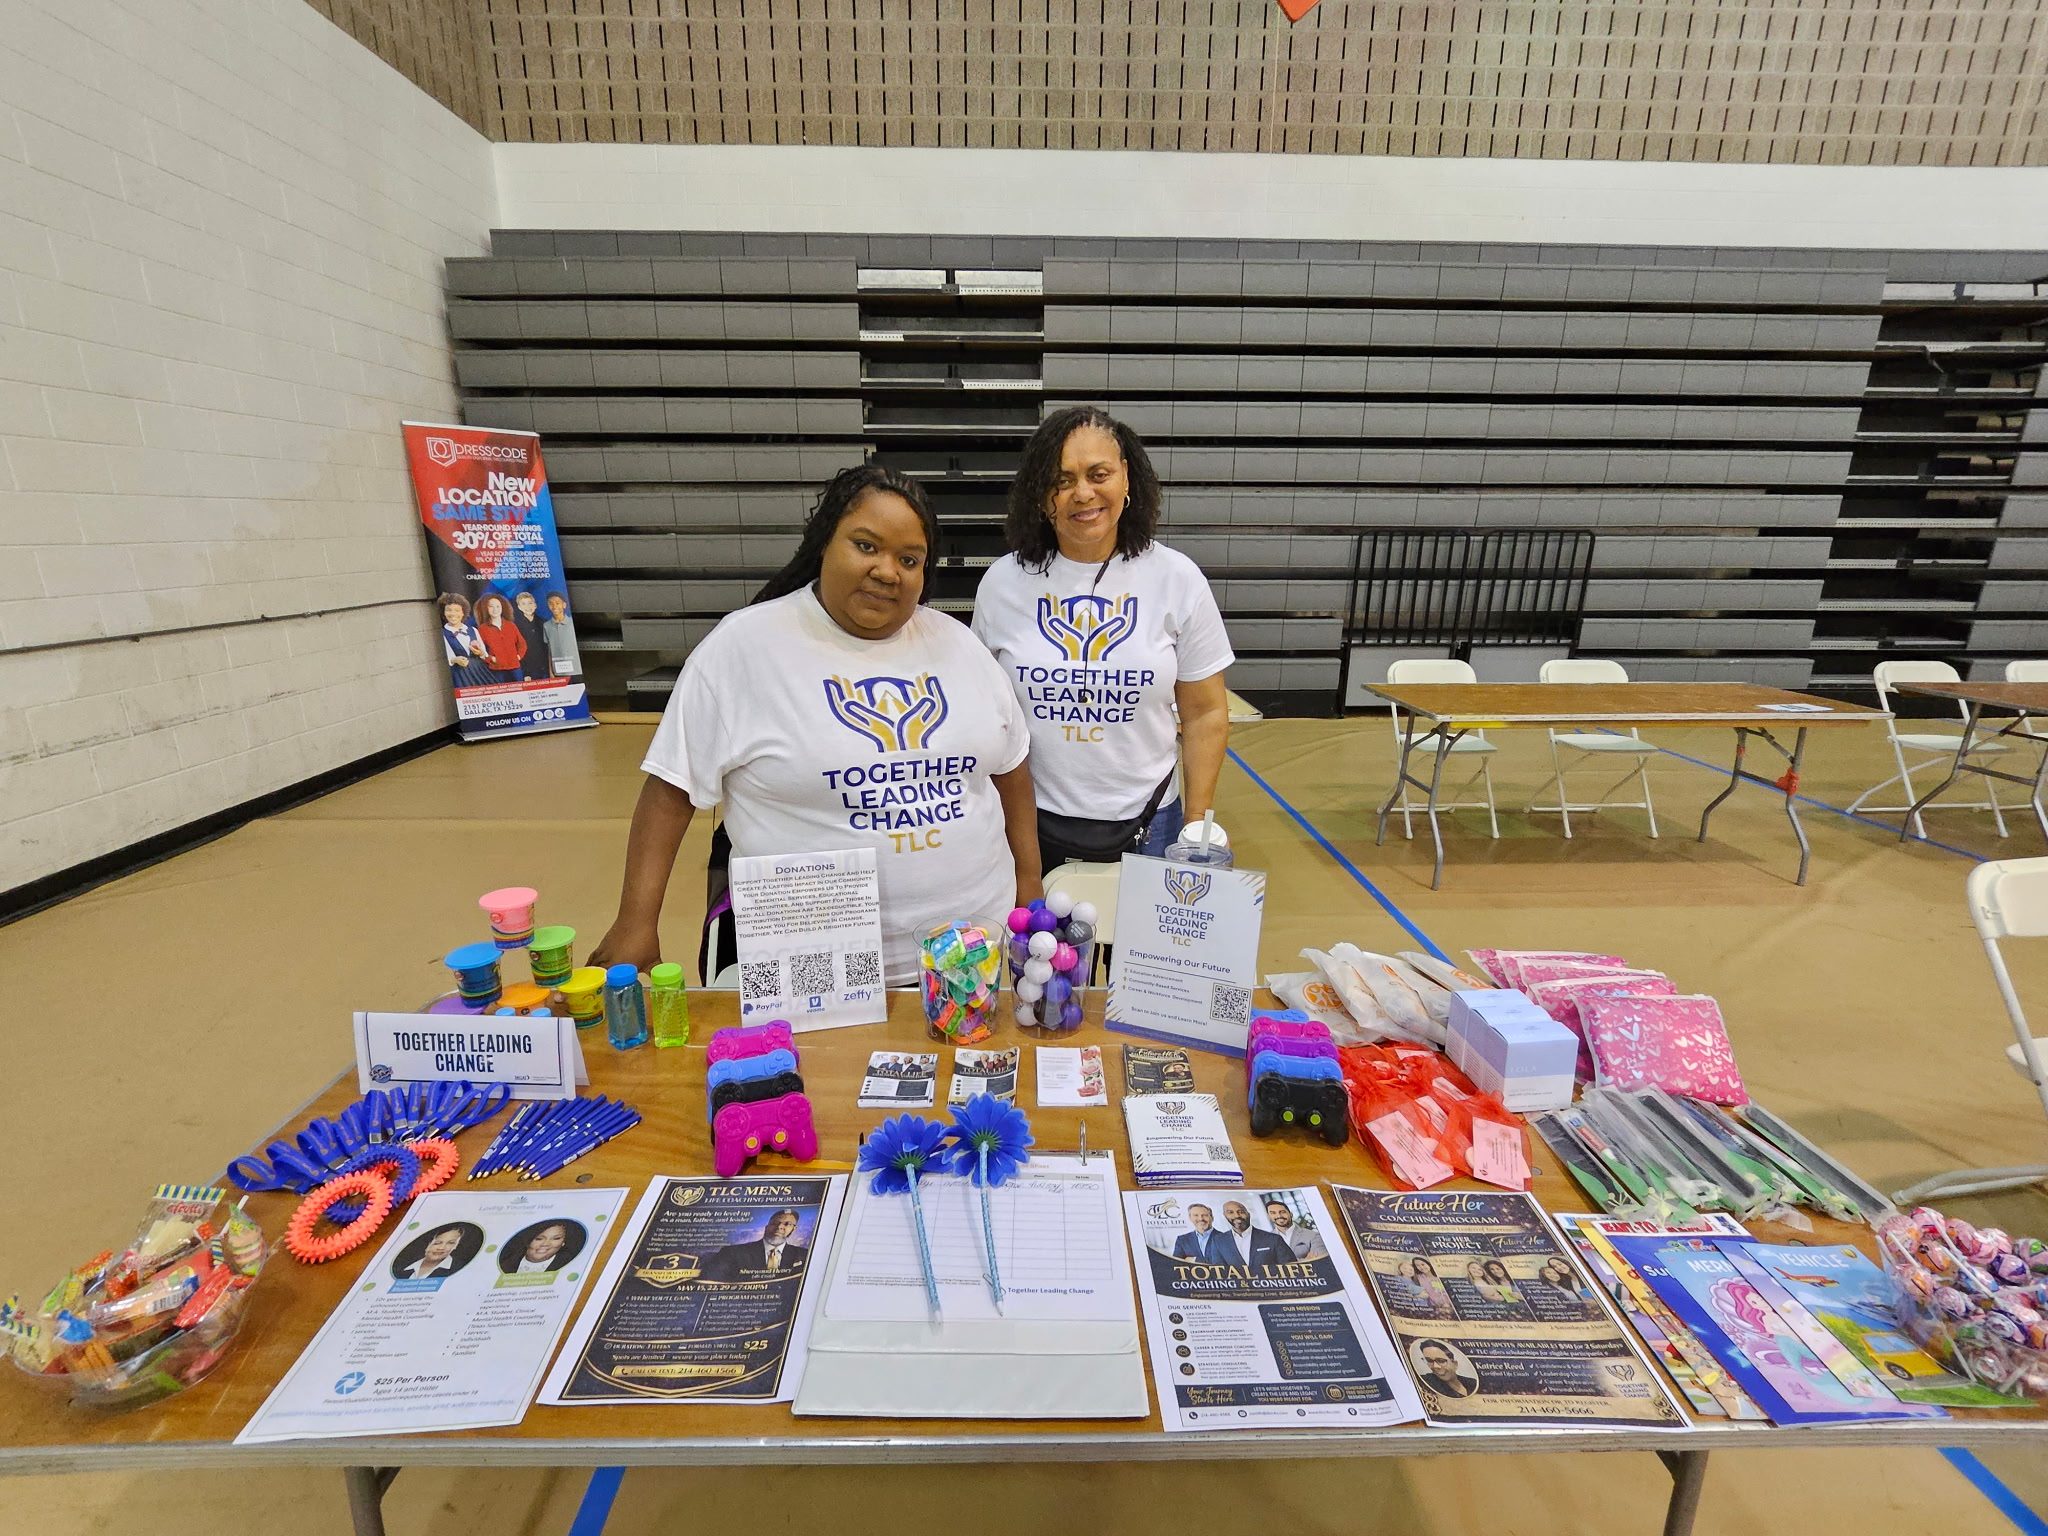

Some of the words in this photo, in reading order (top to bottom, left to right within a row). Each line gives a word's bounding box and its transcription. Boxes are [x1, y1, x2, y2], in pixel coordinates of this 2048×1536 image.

[455, 444, 527, 460] DRESSCODE
[488, 472, 536, 491] New
[438, 487, 538, 507] LOCATION
[431, 504, 486, 521] SAME
[511, 524, 542, 532] SAVINGS
[452, 531, 496, 549] 30%
[492, 531, 512, 540] OFF
[514, 532, 544, 541] TOTAL
[1016, 666, 1155, 687] TOGETHER
[1028, 686, 1141, 705] LEADING
[503, 703, 523, 711] 75229
[1033, 705, 1136, 723] CHANGE
[485, 719, 511, 727] FOLLOW
[1061, 725, 1104, 743] TLC
[822, 756, 977, 790] TOGETHER
[842, 778, 962, 810] LEADING
[850, 800, 965, 831] CHANGE
[888, 828, 943, 853] TLC
[1154, 904, 1215, 922] TOGETHER
[1158, 914, 1208, 930] LEADING
[1158, 924, 1206, 940] CHANGE
[1171, 935, 1192, 947] TLC
[1129, 949, 1182, 966] Empowering
[1184, 959, 1200, 968] Our
[1202, 962, 1231, 974] Future
[843, 989, 872, 1002] zeffy
[755, 1001, 782, 1011] PayPal
[393, 1032, 465, 1053] TOGETHER
[469, 1034, 532, 1054] LEADING
[435, 1053, 495, 1073] CHANGE
[709, 1186, 742, 1196] TLC
[744, 1185, 792, 1196] MEN'S
[1380, 1193, 1447, 1215] Future
[1447, 1193, 1485, 1212] Her
[678, 1211, 692, 1219] you
[692, 1210, 713, 1218] ready
[723, 1209, 739, 1217] level
[1379, 1215, 1440, 1224] COACHING
[1441, 1215, 1500, 1224] PROGRAM
[1360, 1232, 1393, 1244] Future
[1392, 1234, 1414, 1245] Her
[1431, 1241, 1482, 1250] PROJECT
[1491, 1235, 1524, 1247] Future
[1524, 1235, 1546, 1247] Her
[663, 1255, 679, 1270] 3
[1775, 1252, 1849, 1267] VEHICLE
[1173, 1264, 1259, 1281] TOTAL
[1261, 1263, 1318, 1279] LIFE
[1007, 1286, 1039, 1295] Together
[1040, 1286, 1068, 1295] Leading
[1068, 1287, 1095, 1295] Change
[1171, 1279, 1237, 1290] COACHING
[1240, 1279, 1249, 1288] &
[1252, 1277, 1327, 1289] CONSULTING
[743, 1339, 769, 1350] $25
[1458, 1341, 1491, 1349] LIMITED
[1491, 1341, 1516, 1349] SPOTS
[1558, 1342, 1573, 1350] $50
[1574, 1342, 1583, 1351] for
[1590, 1342, 1623, 1351] Saturdays
[1476, 1362, 1505, 1370] Katrice
[1505, 1362, 1525, 1370] Reed
[374, 1376, 393, 1386] $25
[395, 1375, 413, 1385] Per
[414, 1373, 449, 1383] Person
[372, 1387, 392, 1395] Ages
[1186, 1386, 1204, 1398] Your
[1205, 1386, 1233, 1398] Journey
